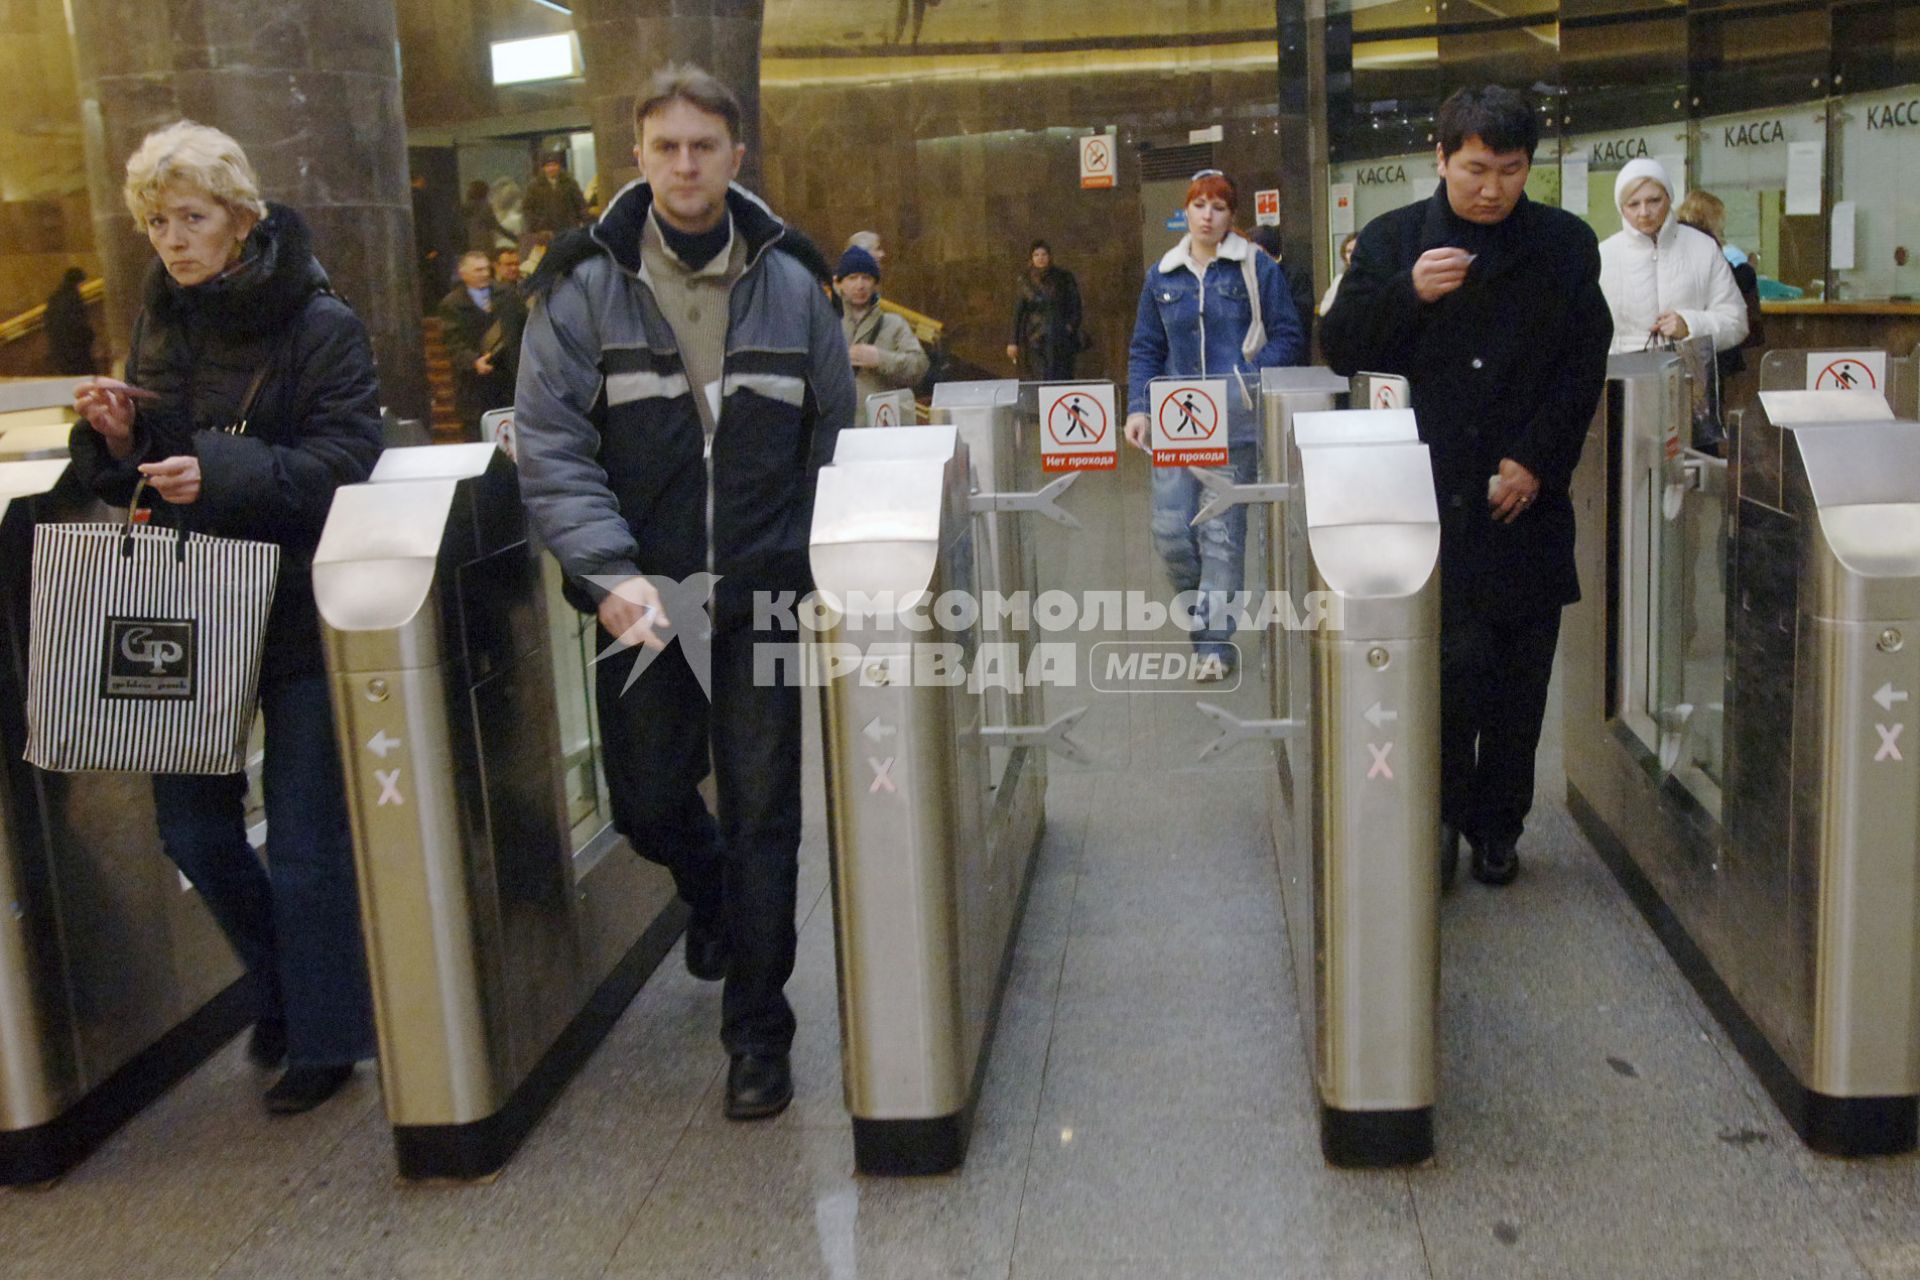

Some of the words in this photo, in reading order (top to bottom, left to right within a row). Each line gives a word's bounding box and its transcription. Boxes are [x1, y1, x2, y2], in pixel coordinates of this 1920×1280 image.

[1723, 120, 1785, 148] КАССА
[1592, 137, 1649, 162] КАССА
[1356, 165, 1407, 186] КАССА
[1045, 456, 1066, 467] Нет
[1068, 455, 1115, 468] прохода
[1155, 452, 1176, 463] Нет
[1178, 451, 1226, 464] прохода
